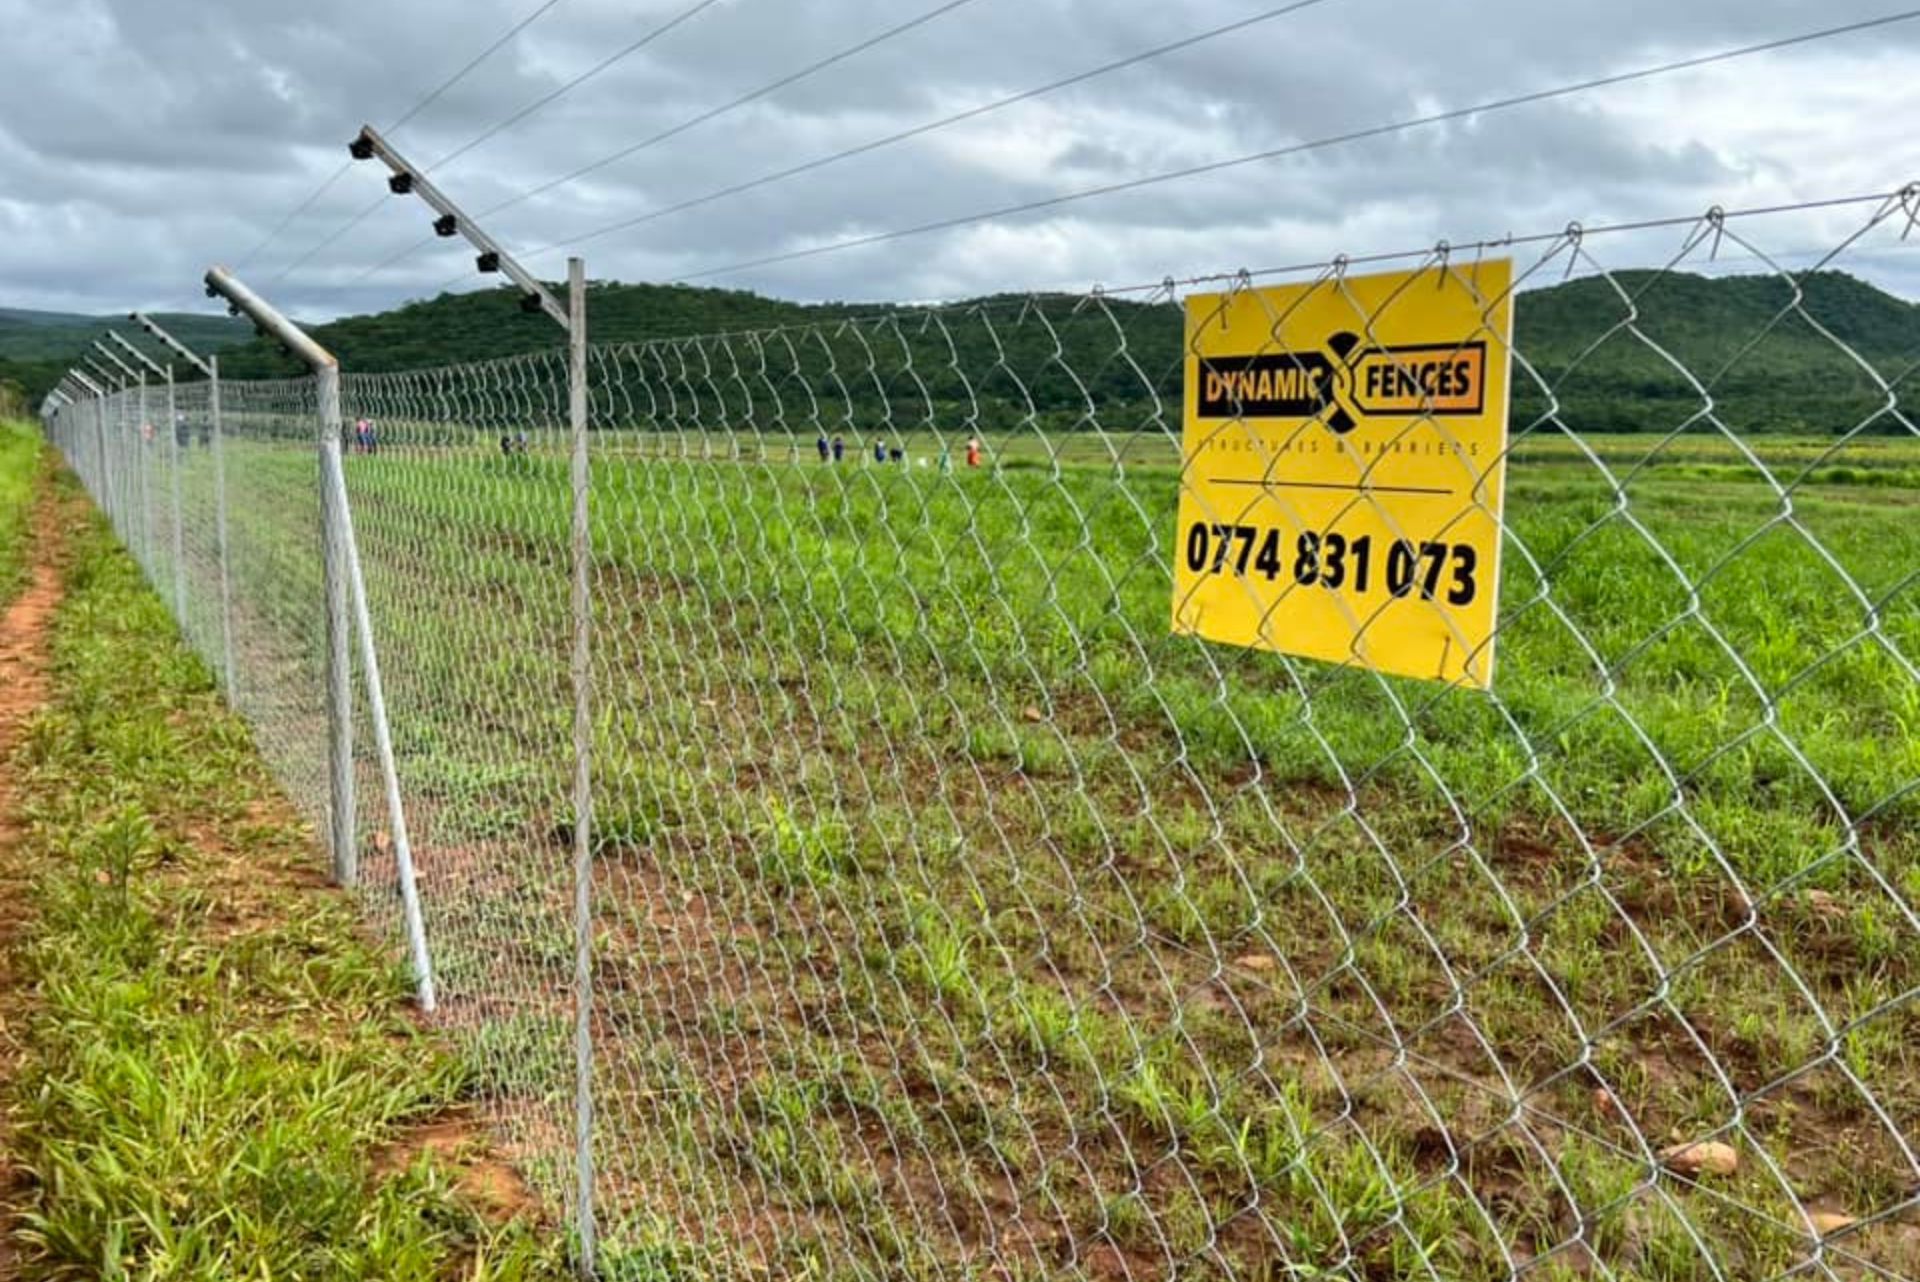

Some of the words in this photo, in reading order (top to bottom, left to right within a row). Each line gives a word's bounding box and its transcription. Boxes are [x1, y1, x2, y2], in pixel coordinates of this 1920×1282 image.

[1206, 366, 1325, 402] DYNAMIC
[1366, 360, 1470, 398] FENCES
[1187, 522, 1280, 581] 0774
[1294, 531, 1371, 592] 831
[1387, 539, 1476, 606] 073
